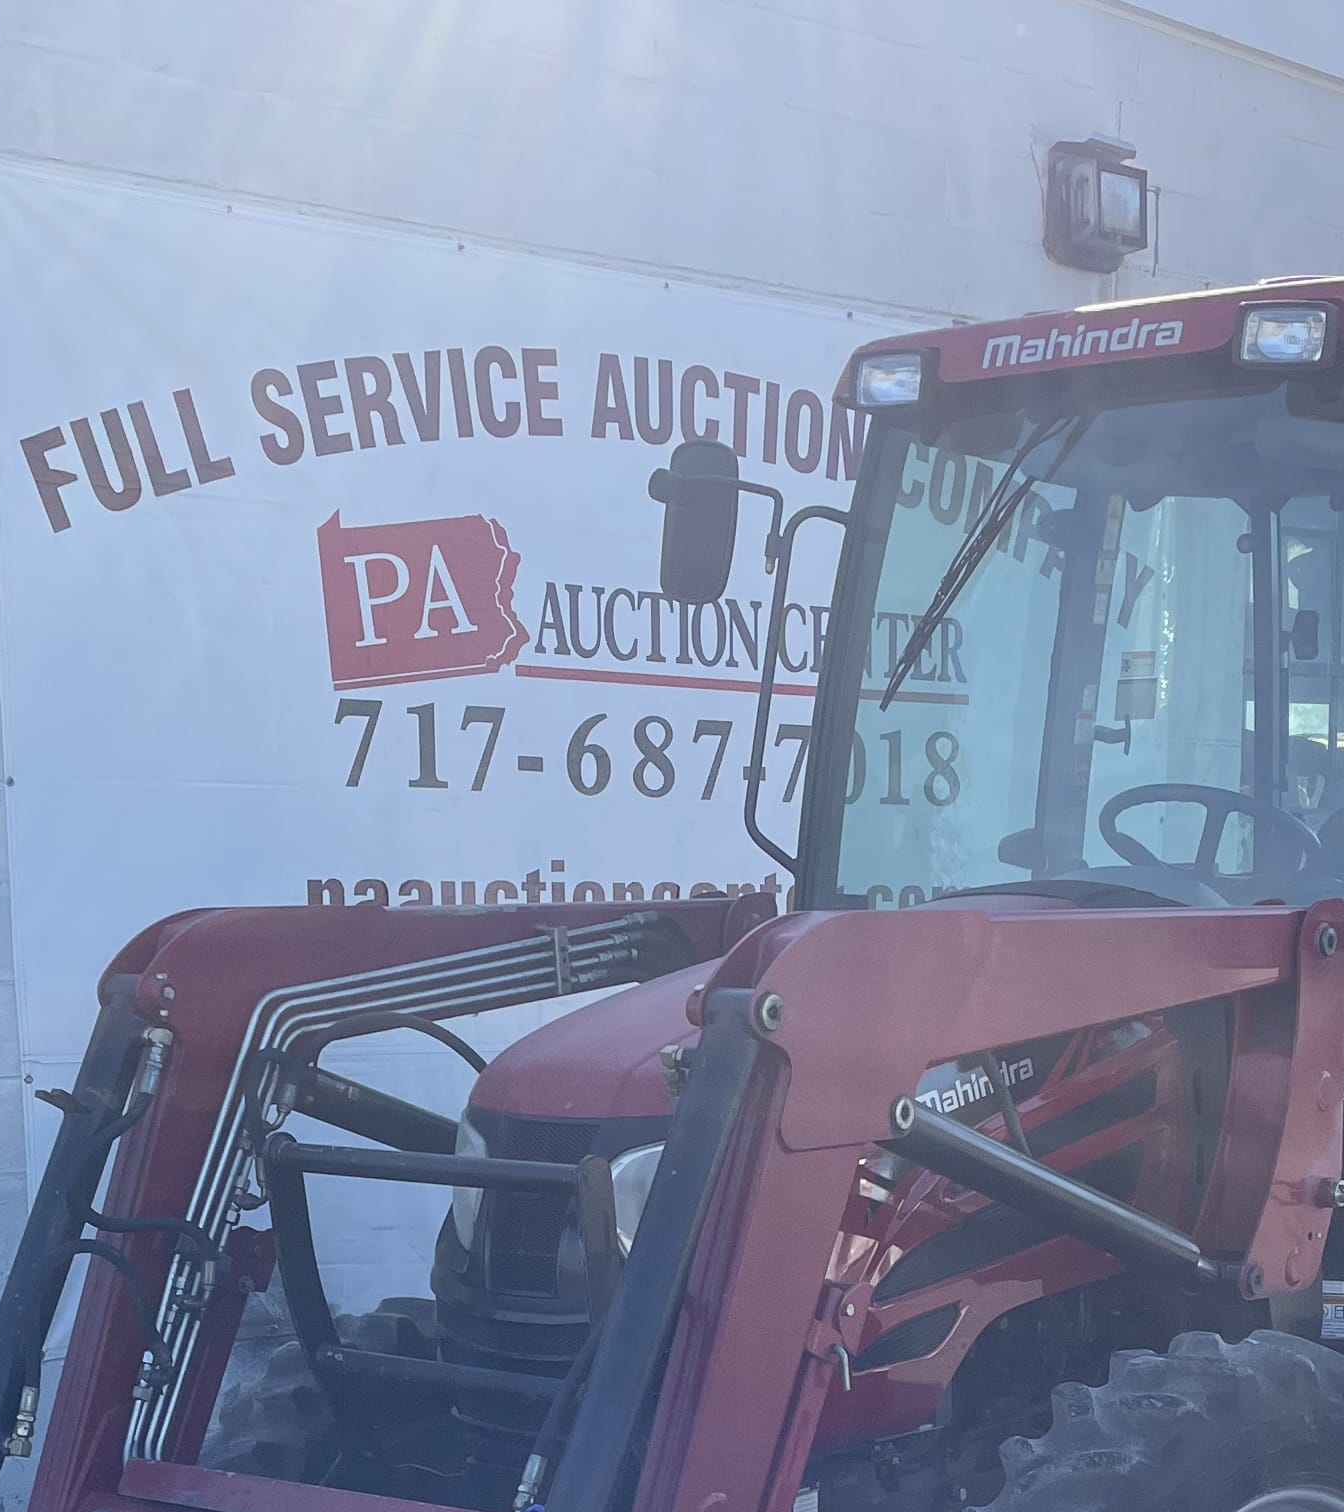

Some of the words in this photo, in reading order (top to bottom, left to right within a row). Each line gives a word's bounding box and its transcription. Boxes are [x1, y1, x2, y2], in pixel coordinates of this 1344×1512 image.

[982, 318, 1184, 369] Mahindra
[19, 387, 236, 534] FULL
[250, 345, 563, 466] SERVICE
[590, 352, 870, 482] AUCTION
[896, 436, 1155, 629] COMPY
[343, 544, 479, 648] PA
[534, 581, 762, 671] AUCTION
[776, 602, 967, 683] CETER
